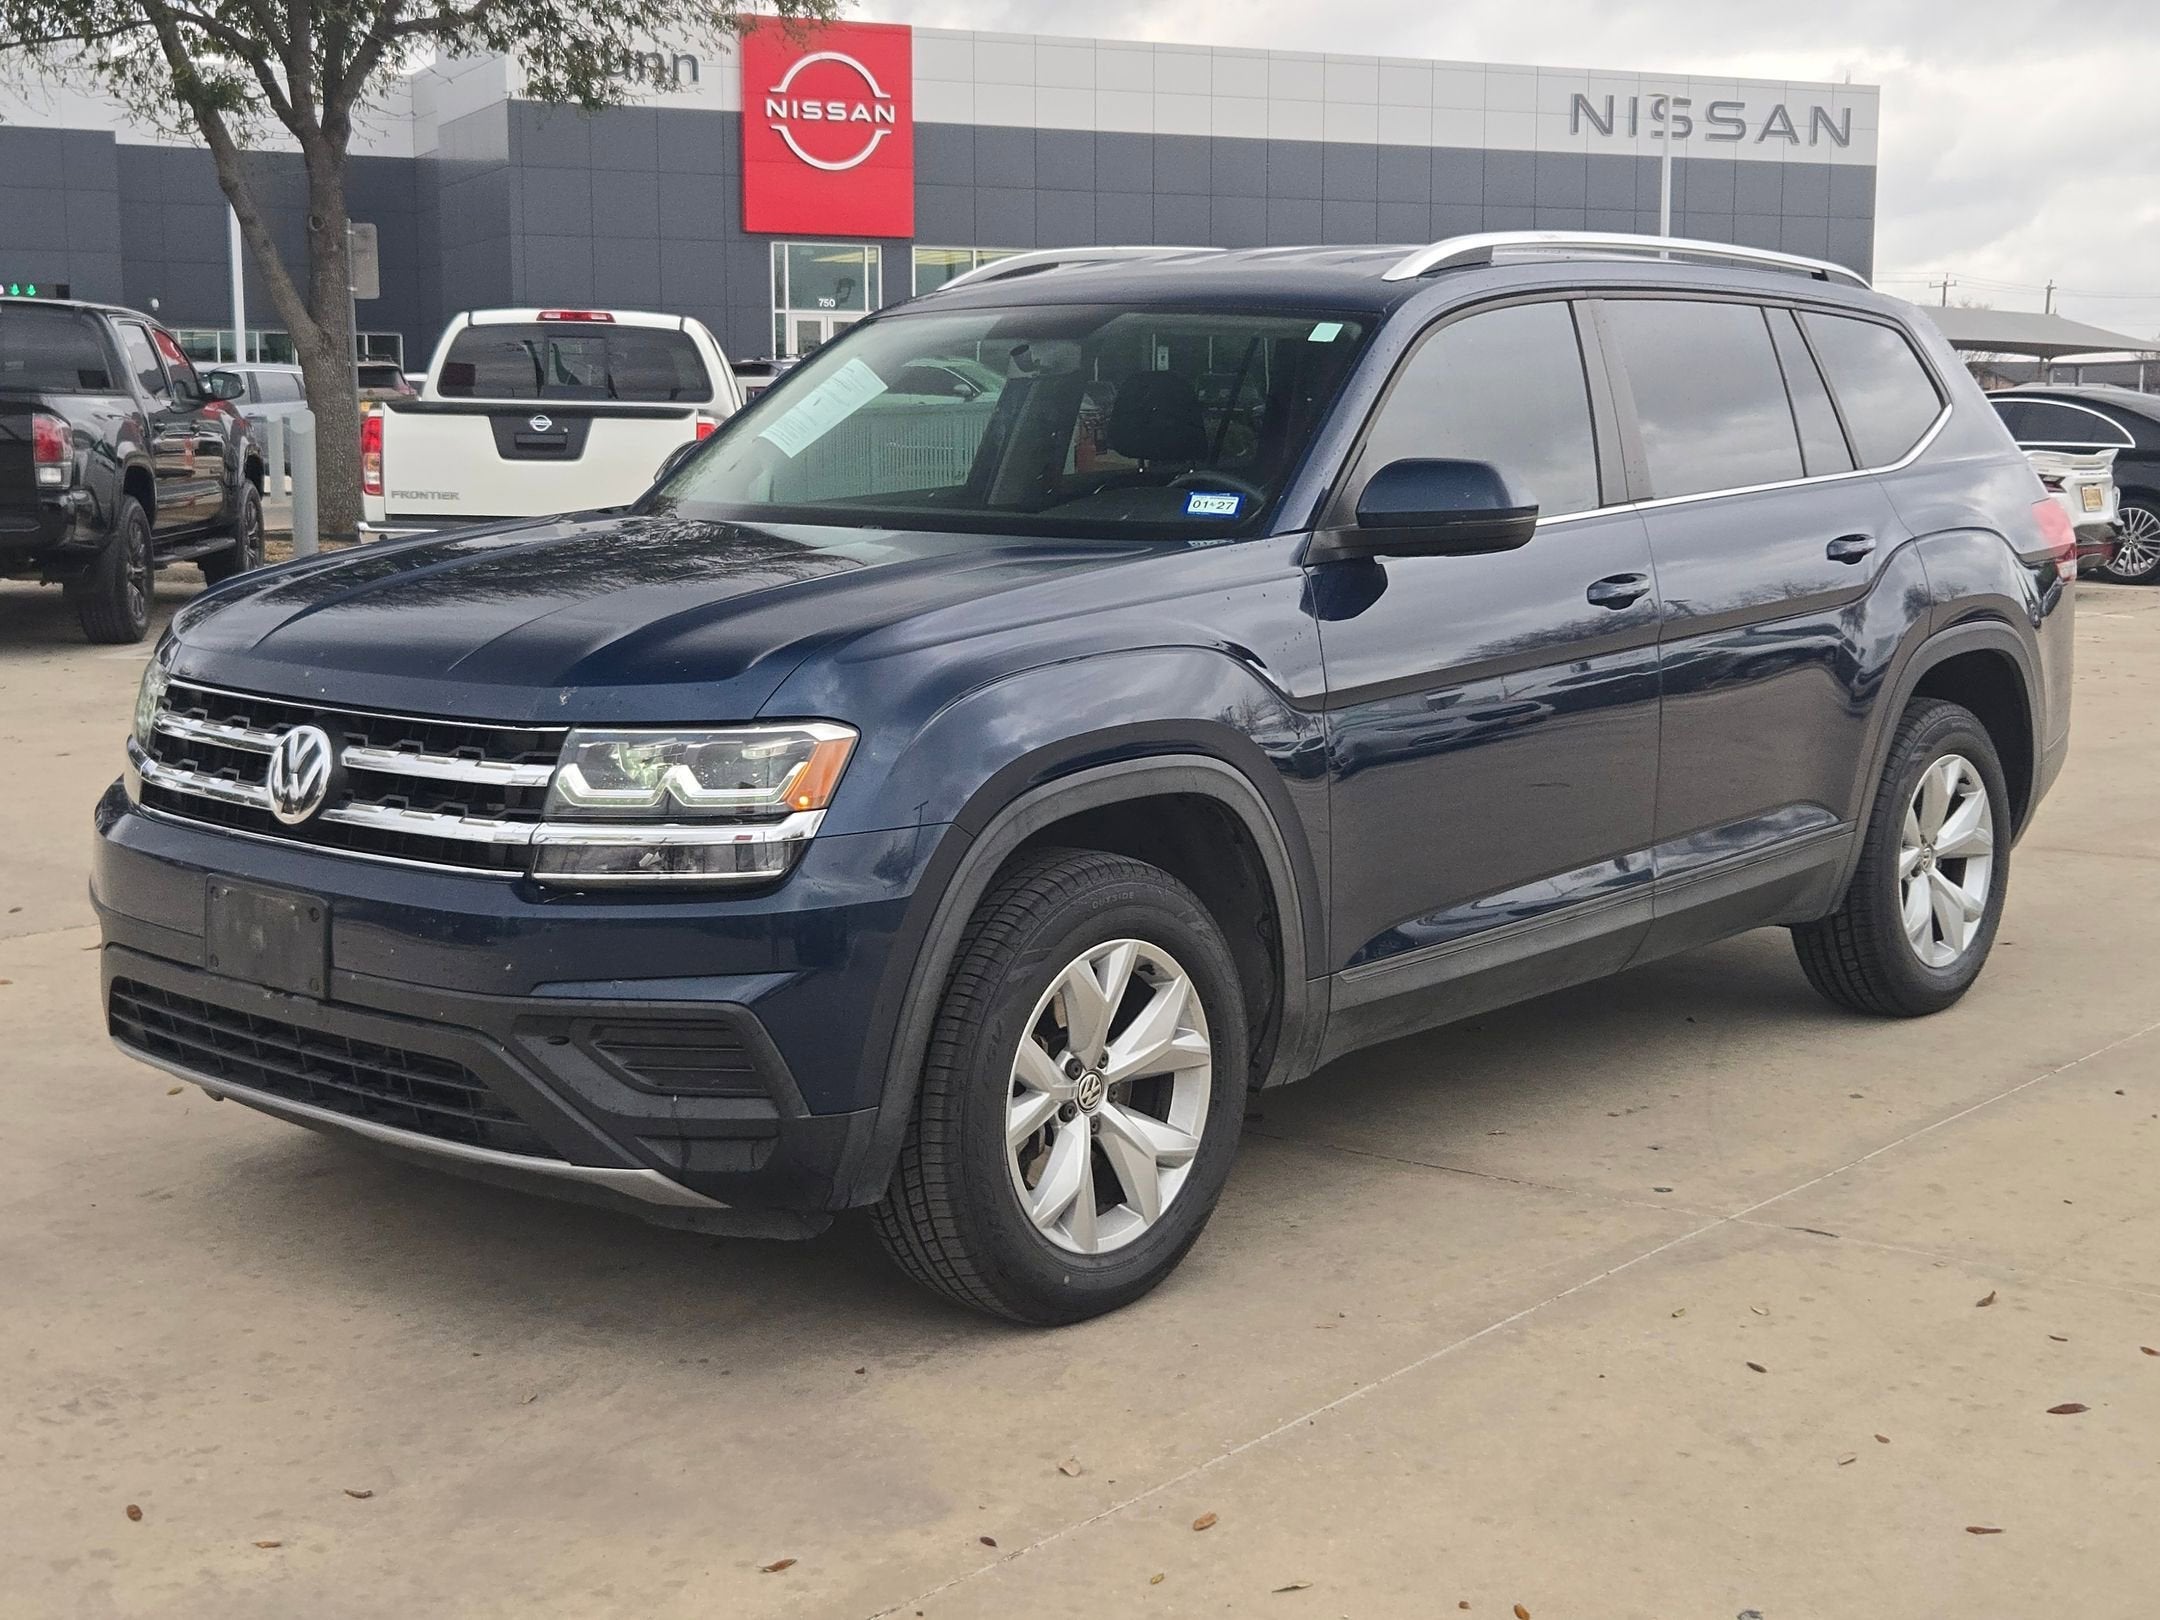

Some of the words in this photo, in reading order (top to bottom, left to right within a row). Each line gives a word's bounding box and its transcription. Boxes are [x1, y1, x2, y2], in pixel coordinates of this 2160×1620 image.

[766, 99, 895, 123] NISSAN
[1570, 93, 1852, 147] NISSAN
[818, 298, 836, 308] 750
[391, 490, 460, 500] FRONTIER
